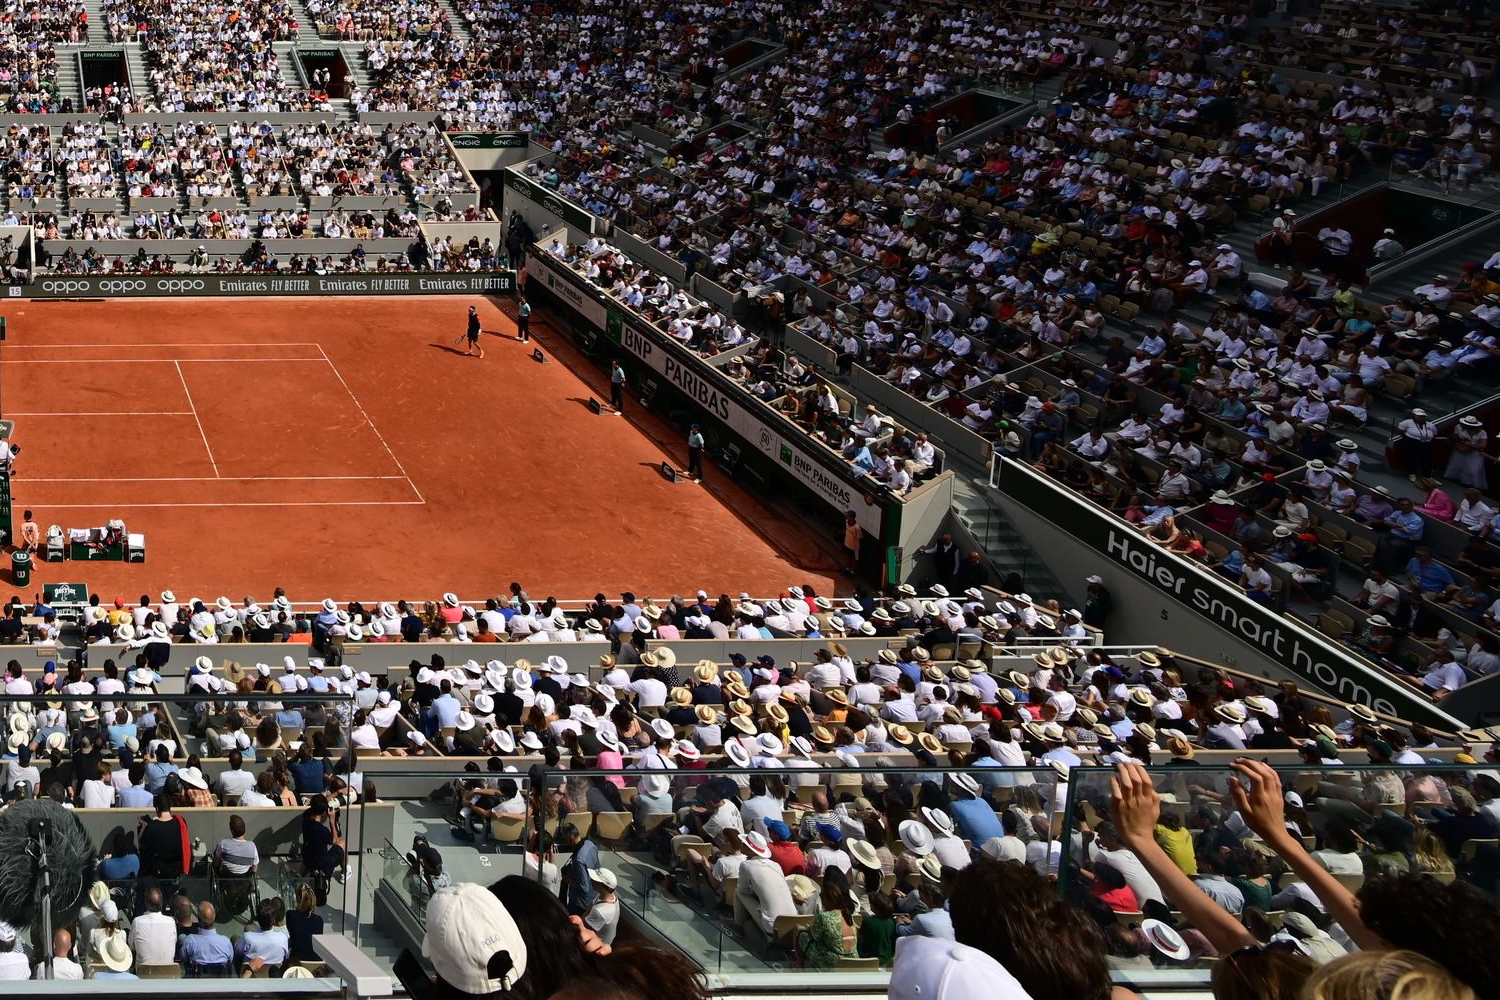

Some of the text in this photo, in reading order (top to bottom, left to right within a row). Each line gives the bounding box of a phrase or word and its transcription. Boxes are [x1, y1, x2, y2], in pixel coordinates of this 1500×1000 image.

[42, 280, 90, 294] oppo
[99, 280, 147, 293] oppo
[157, 279, 205, 293] oppo
[219, 279, 310, 292] Emirates FLY BETTER
[319, 279, 410, 291] Emirates FLY BETTER
[419, 278, 510, 290] Emirates FLY BETTER
[10, 287, 20, 295] 15
[624, 326, 729, 420] BNP PARIBAS
[794, 455, 851, 504] BNP PARIBAS
[1160, 608, 1169, 620] 5
[1106, 529, 1398, 717] Haier smart home
[479, 855, 491, 867] 03
[480, 933, 501, 948] POLO
